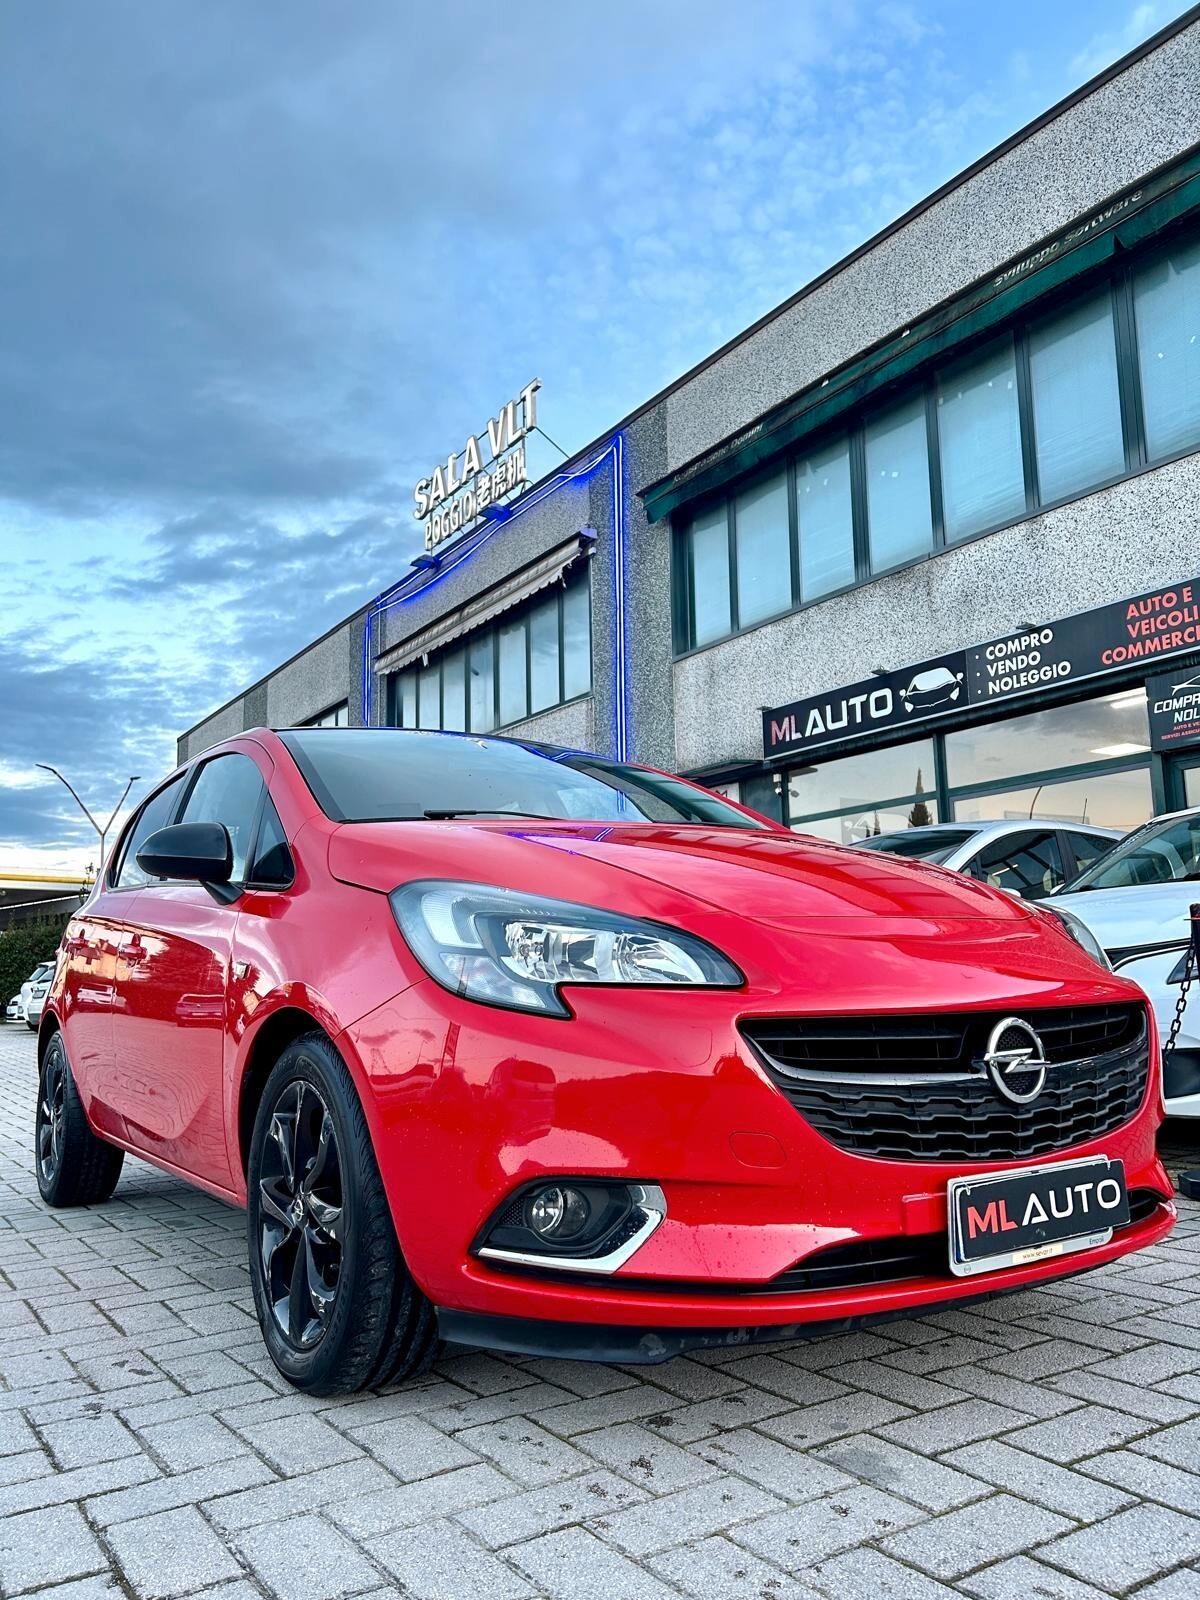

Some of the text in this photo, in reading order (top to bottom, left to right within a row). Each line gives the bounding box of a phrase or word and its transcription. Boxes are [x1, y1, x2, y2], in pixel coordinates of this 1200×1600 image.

[413, 376, 543, 520] SALA VLT
[476, 448, 527, 514] 老虎机
[425, 490, 478, 551] POGGIO
[1126, 586, 1193, 620] AUTO E
[1126, 604, 1200, 638] VEICOLI
[985, 628, 1054, 660] COMPRO
[986, 650, 1041, 677] VENDO
[988, 660, 1072, 695] NOLEGGIO
[1174, 708, 1200, 723] NOL
